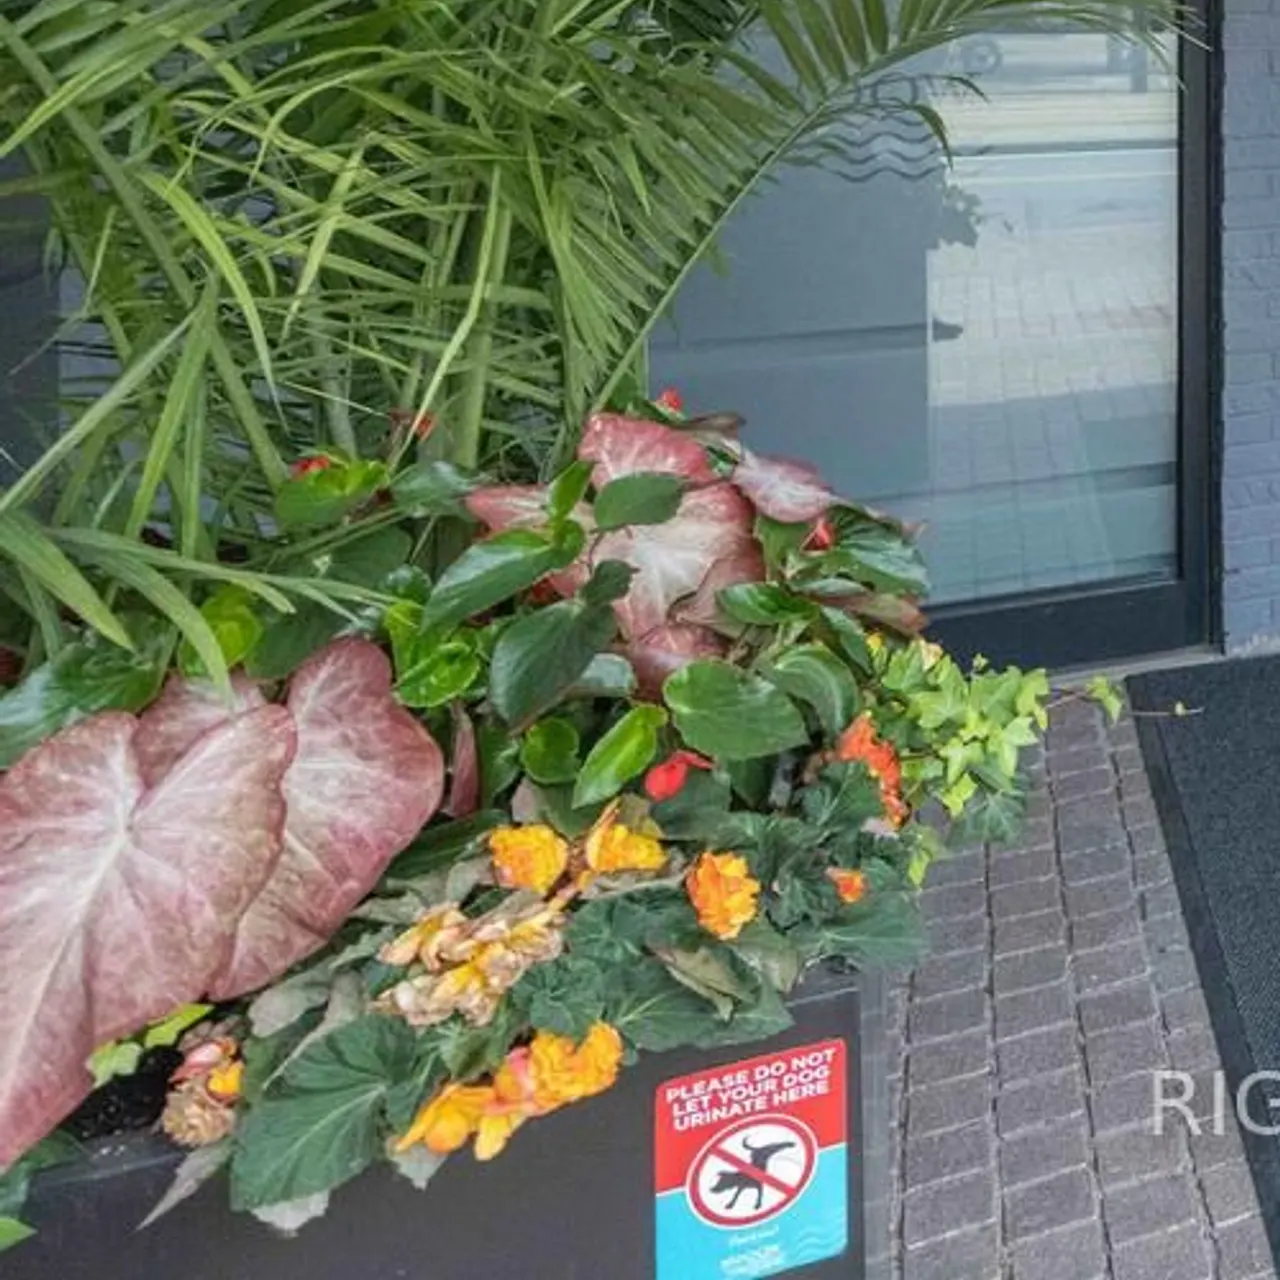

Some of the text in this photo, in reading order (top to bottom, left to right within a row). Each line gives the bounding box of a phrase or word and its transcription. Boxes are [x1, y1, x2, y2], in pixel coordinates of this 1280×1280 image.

[666, 1048, 836, 1102] PLEASE DO NOT
[672, 1065, 830, 1117] LET YOUR DOG
[674, 1080, 829, 1131] URINATE HERE
